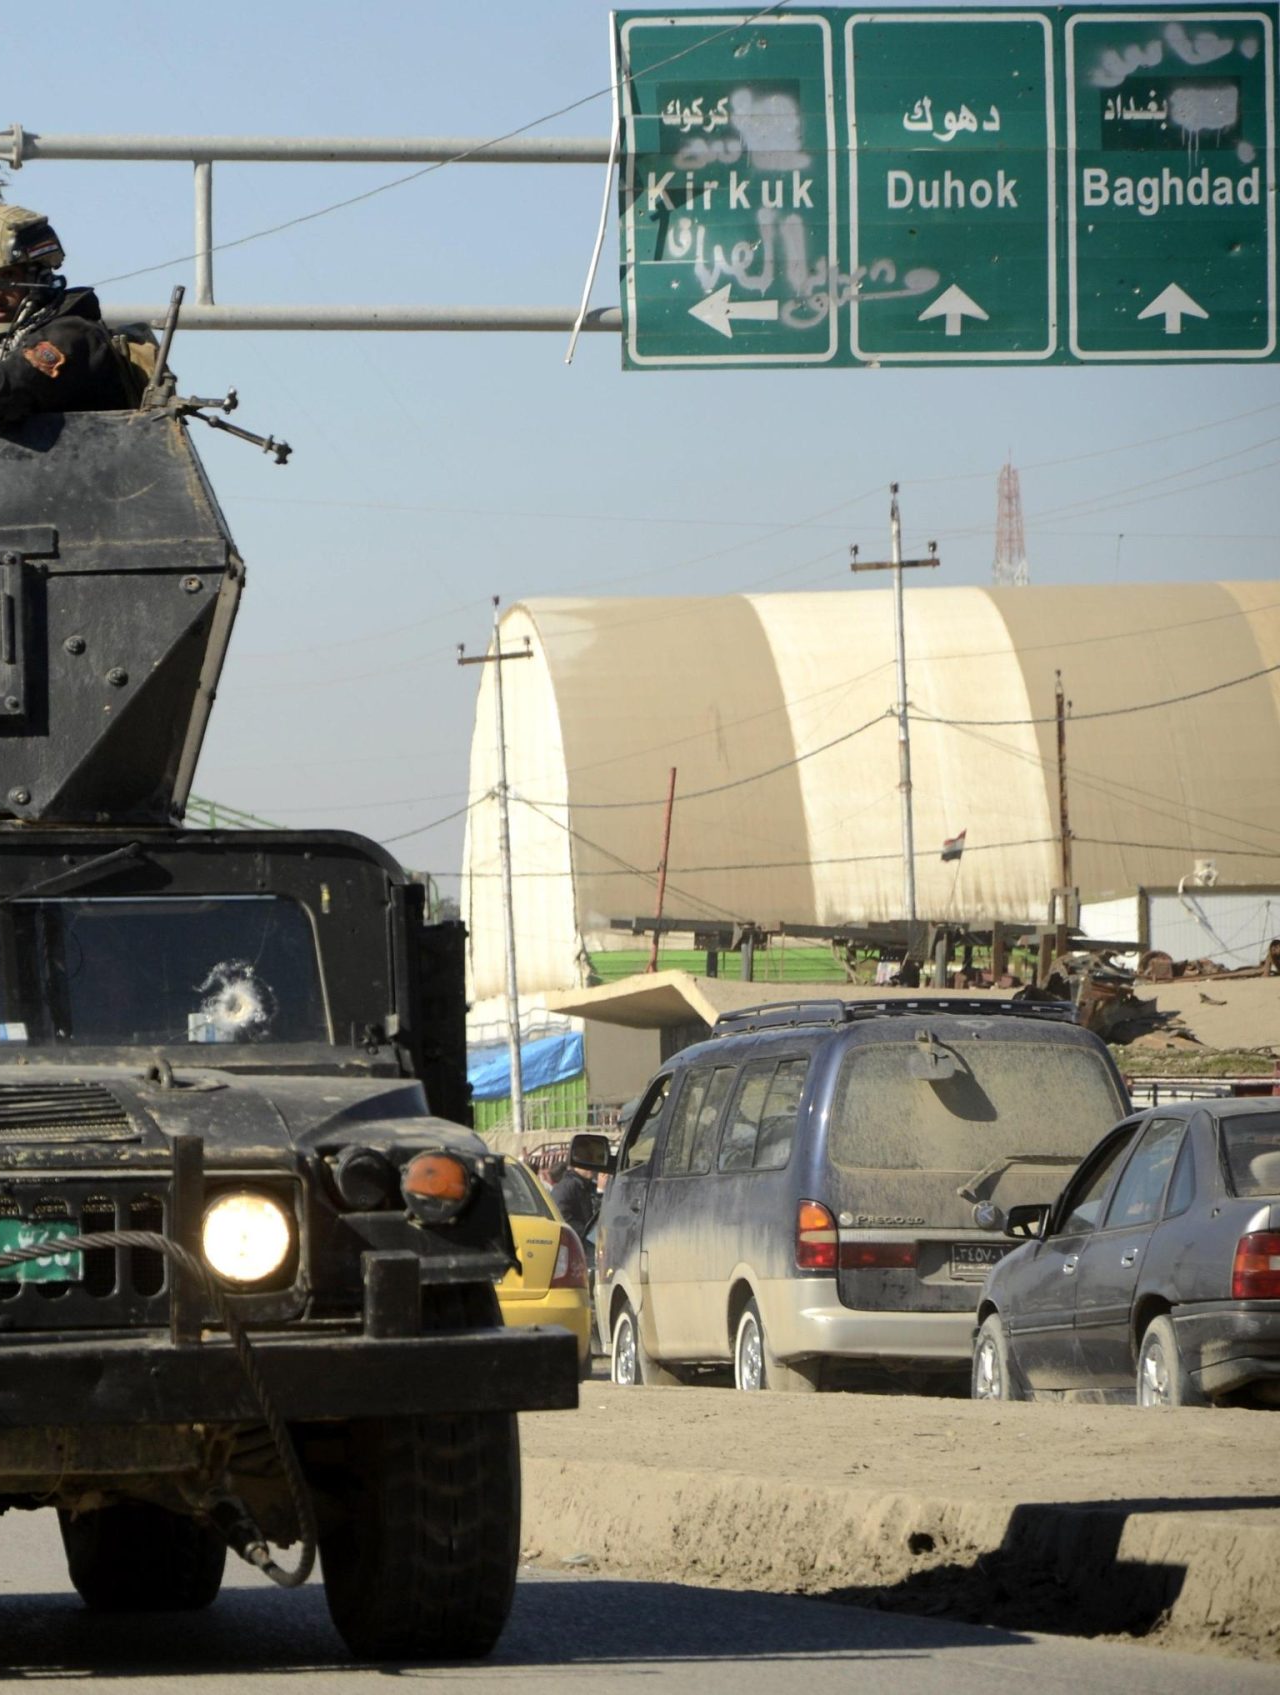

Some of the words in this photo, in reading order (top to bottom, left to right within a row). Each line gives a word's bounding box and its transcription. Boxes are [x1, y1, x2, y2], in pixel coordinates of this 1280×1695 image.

[660, 96, 730, 133] كركوك
[903, 94, 1000, 142] دهوك
[1104, 90, 1169, 131] بغداد
[648, 169, 815, 212] Kirkuk
[887, 168, 1019, 209] Duhok
[1083, 166, 1261, 216] Baghdad
